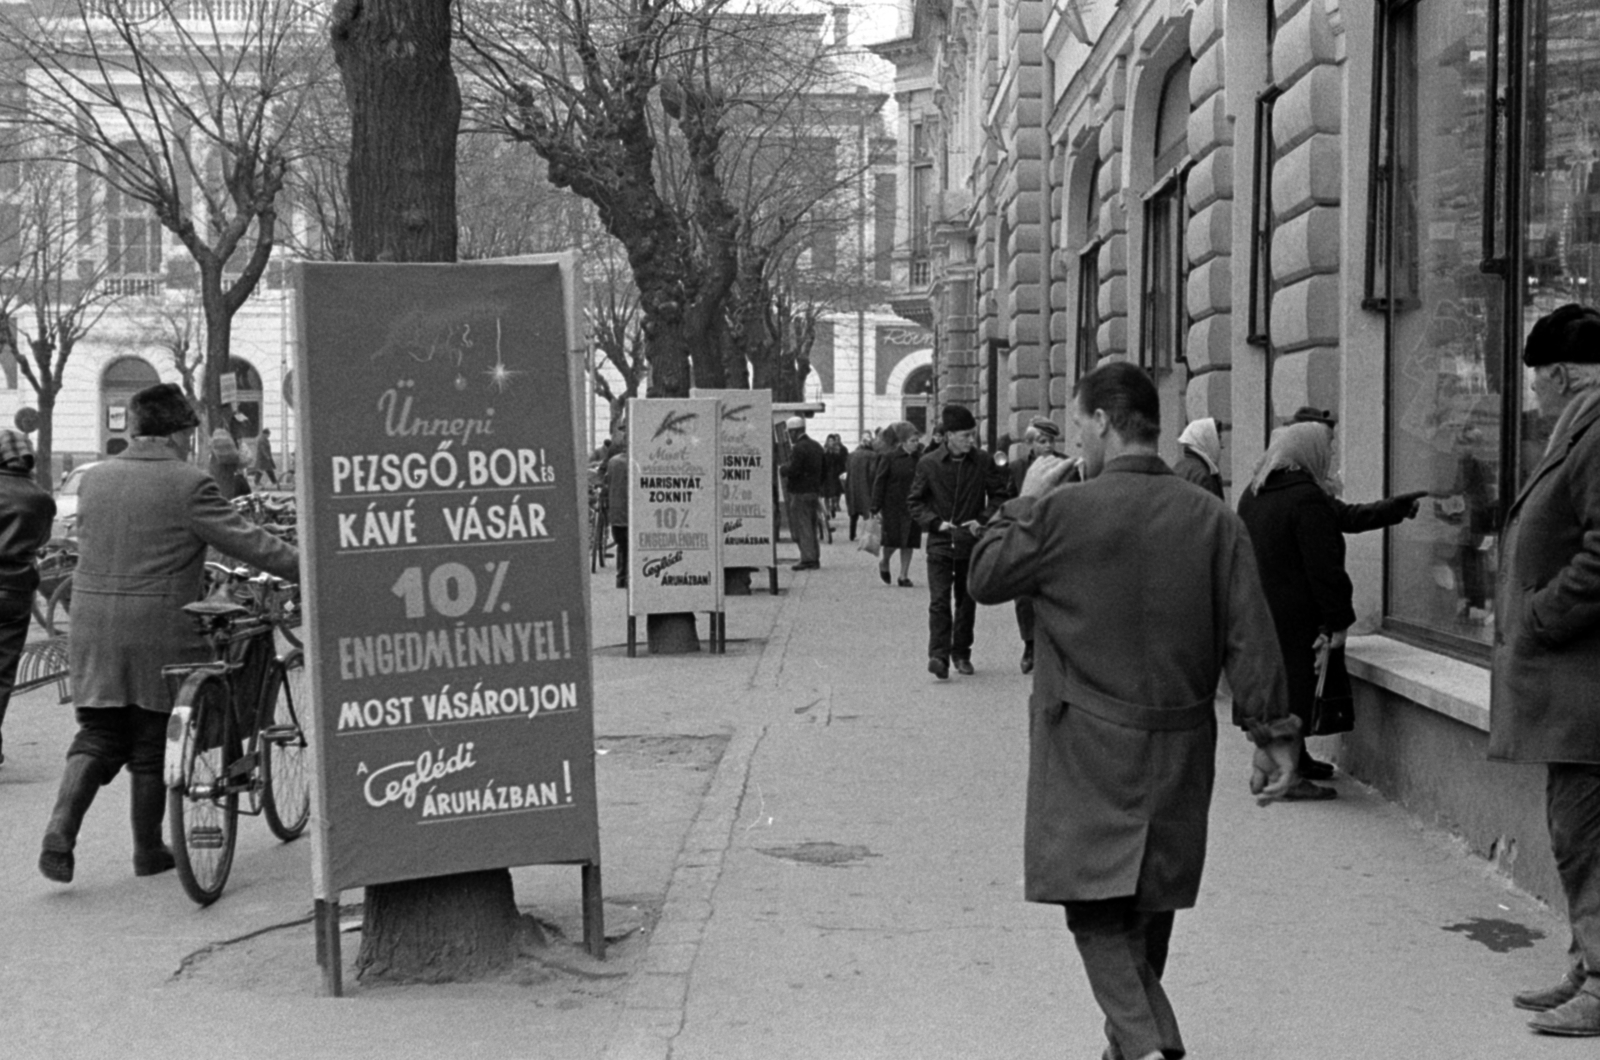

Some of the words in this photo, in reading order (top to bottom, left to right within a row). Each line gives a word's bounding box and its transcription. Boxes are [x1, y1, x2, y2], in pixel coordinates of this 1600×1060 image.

[378, 379, 496, 446] Ünnepi
[332, 440, 466, 493] PEZSGŐ,
[721, 468, 751, 481] KNIT
[722, 483, 740, 500] 0%
[338, 498, 418, 548] KÁVÉ
[443, 494, 548, 541] VÁSÁR
[649, 490, 692, 503] ZOKNIT
[653, 507, 690, 529] 10%
[391, 560, 511, 618] 10%
[338, 610, 571, 680] ENGEDMÉNNYEL!
[337, 697, 414, 730] MOST
[422, 682, 577, 719] VÁSÁROLJON
[356, 761, 368, 775] A
[364, 742, 477, 808] Ceglédi
